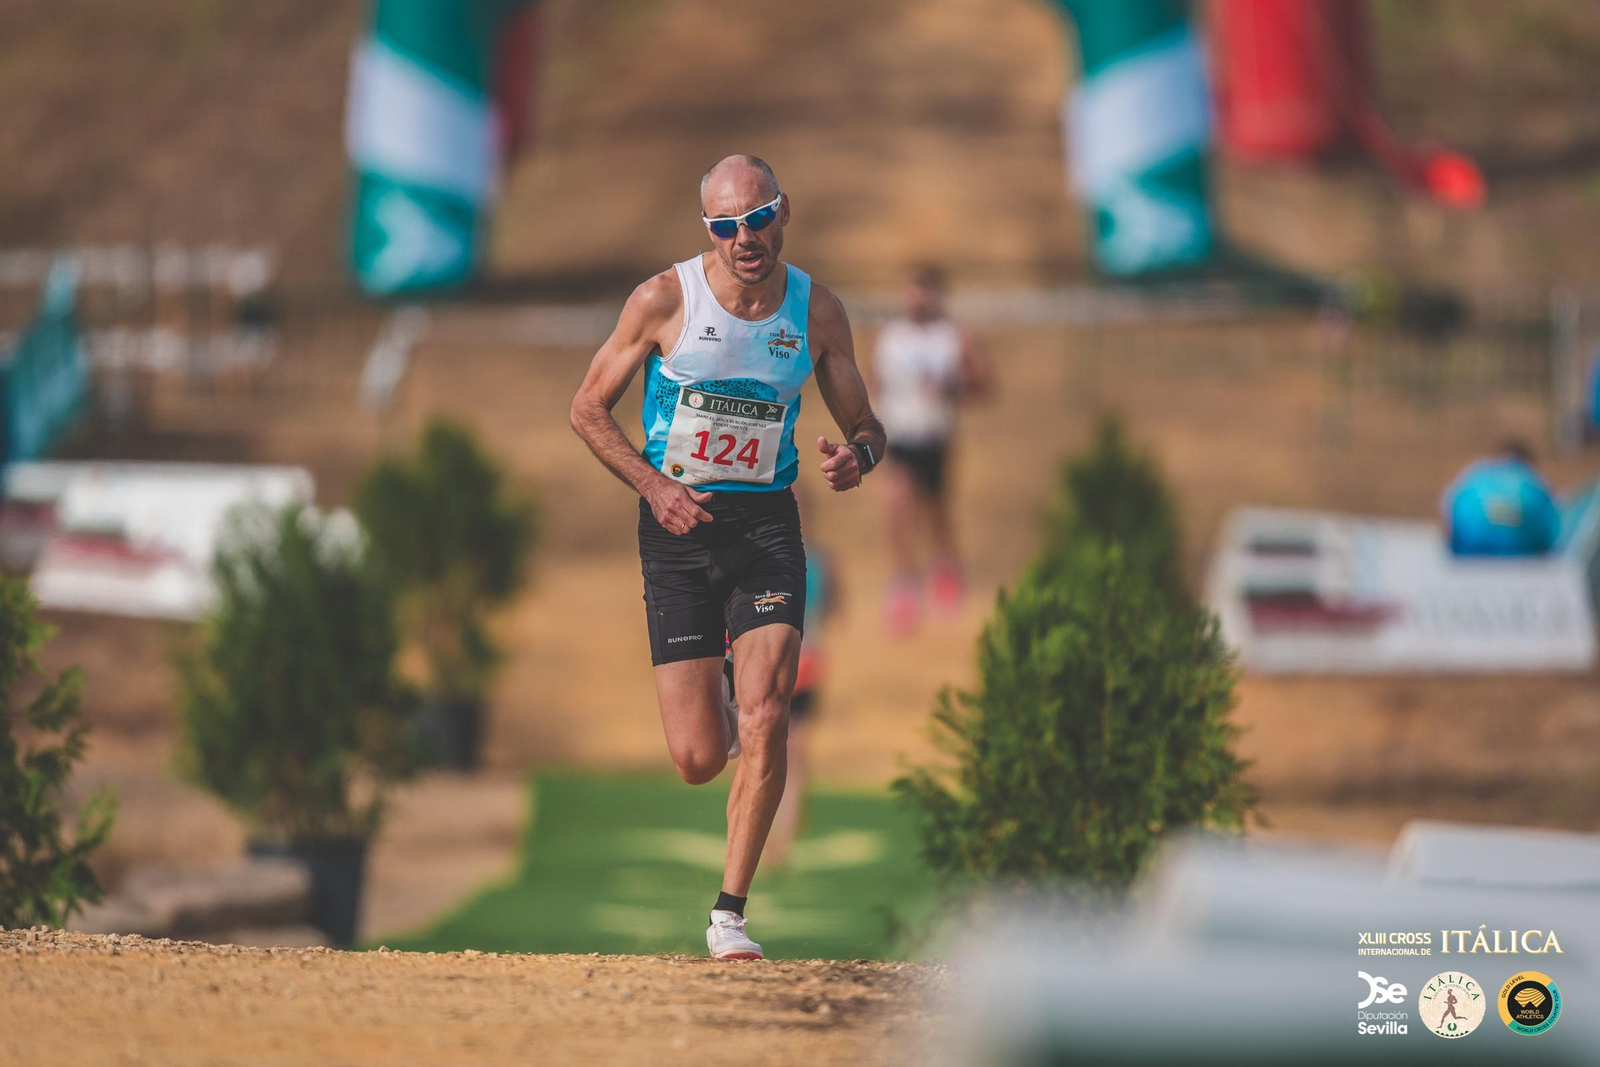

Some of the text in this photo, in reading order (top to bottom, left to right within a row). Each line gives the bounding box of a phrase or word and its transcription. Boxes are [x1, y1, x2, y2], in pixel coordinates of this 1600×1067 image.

[769, 347, 789, 359] Viso
[710, 399, 758, 416] ITÁLICA
[690, 430, 760, 470] 124
[755, 605, 774, 613] Viso
